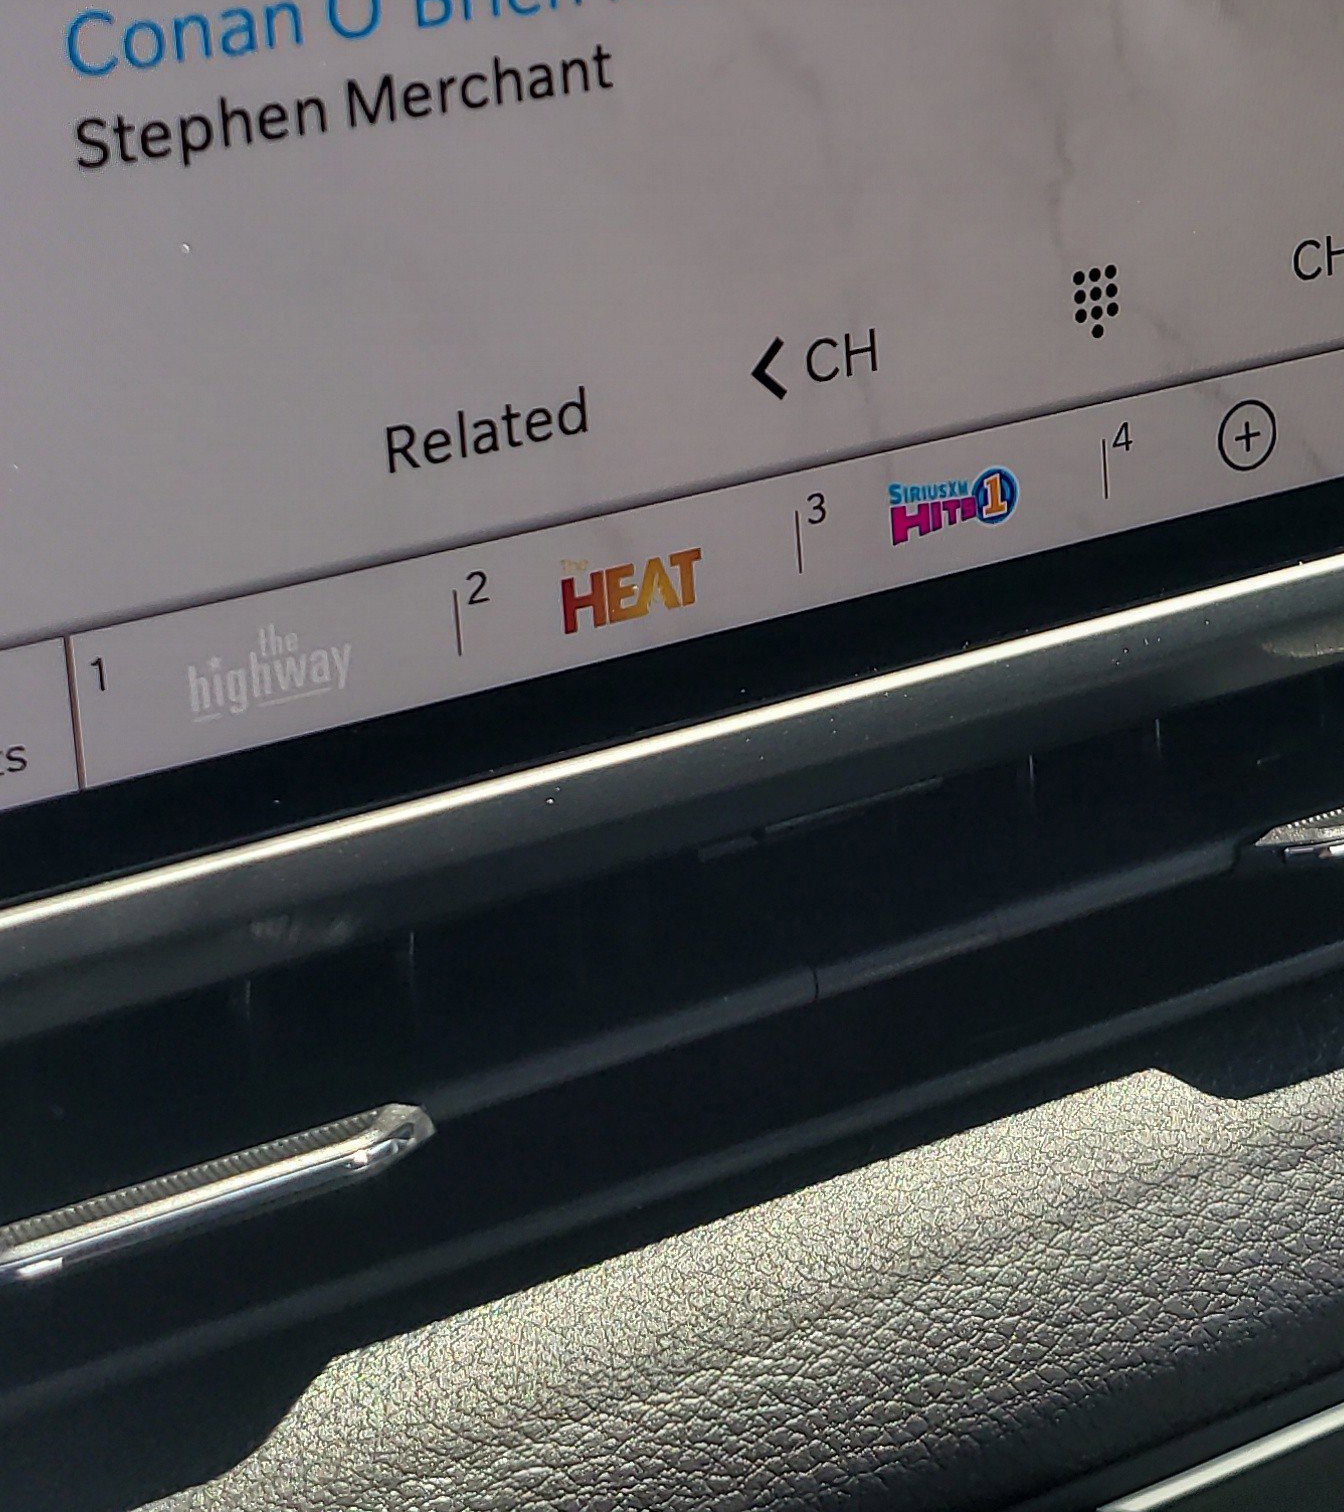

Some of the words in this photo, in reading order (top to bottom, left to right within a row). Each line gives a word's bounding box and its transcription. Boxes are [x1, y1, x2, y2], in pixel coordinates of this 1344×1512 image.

[66, 0, 304, 77] Conan
[76, 93, 328, 171] Stephen
[347, 43, 614, 128] Merchant
[804, 327, 881, 384] CH
[384, 385, 590, 474] Related
[1111, 422, 1134, 453] 4
[806, 494, 827, 525] 3
[983, 473, 1008, 517] 1
[466, 570, 491, 605] 2
[561, 547, 702, 635] HEAT
[258, 624, 299, 654] the
[90, 656, 108, 692] 1
[187, 642, 352, 714] highway
